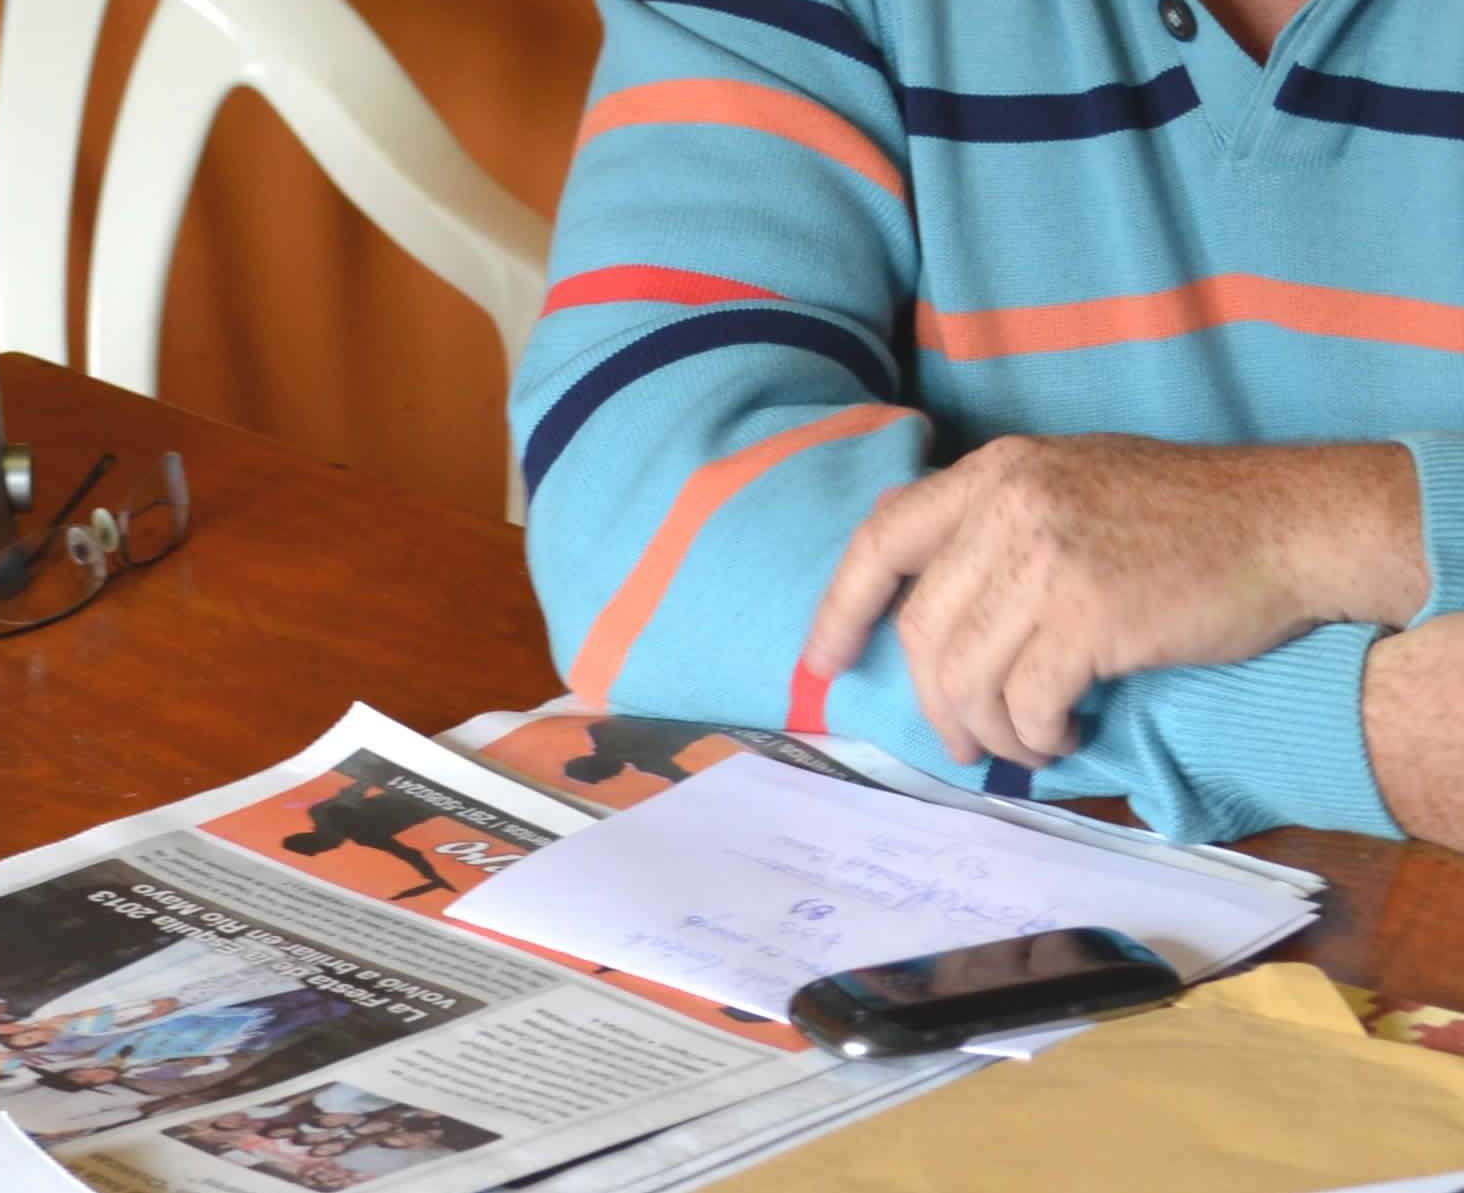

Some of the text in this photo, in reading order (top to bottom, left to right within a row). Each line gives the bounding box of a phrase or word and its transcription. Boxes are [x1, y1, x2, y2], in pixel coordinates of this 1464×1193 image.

[87, 889, 157, 920] 2013
[130, 883, 205, 921] Mayo
[199, 911, 250, 937] Río
[247, 929, 283, 950] en
[275, 959, 311, 979] de
[281, 943, 357, 977] brillar
[354, 968, 374, 981] a
[308, 972, 390, 1008] Fiesta
[377, 975, 460, 1010] volvió
[386, 1001, 430, 1024] La
